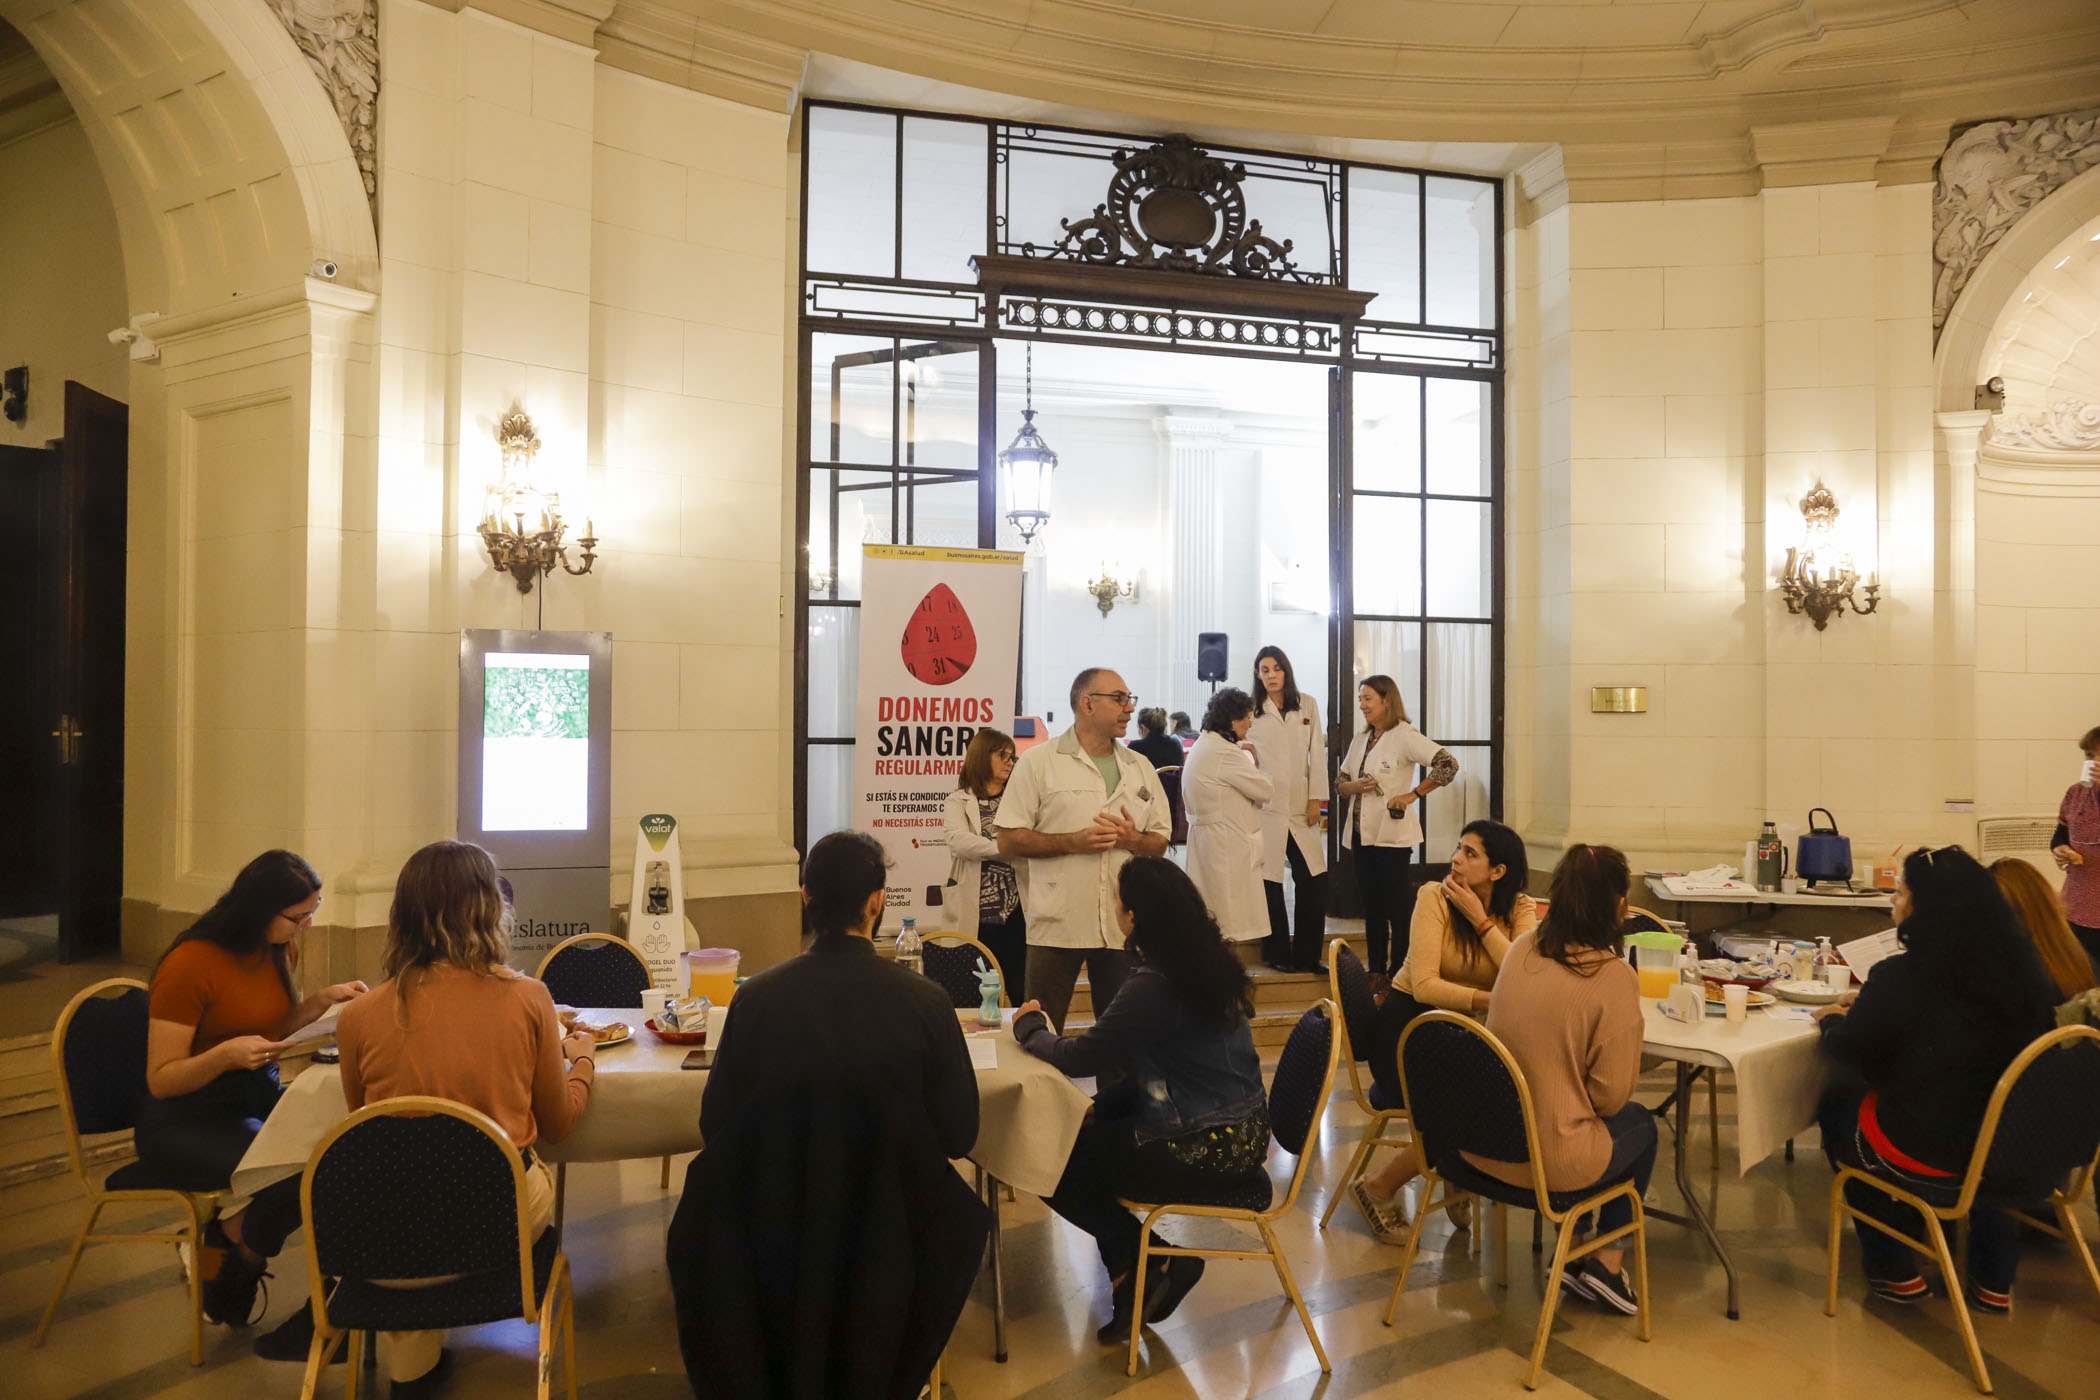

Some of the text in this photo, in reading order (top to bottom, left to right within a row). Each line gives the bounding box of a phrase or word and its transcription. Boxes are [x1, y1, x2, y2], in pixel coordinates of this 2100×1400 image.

[925, 626, 940, 643] 24
[932, 657, 946, 675] 31
[878, 696, 994, 723] DONEMOS
[877, 725, 992, 757] SANGR
[866, 793, 874, 802] SI
[875, 789, 897, 802] ESTÁS
[899, 792, 908, 801] EN
[883, 804, 891, 813] TE
[893, 804, 938, 813] ESPERAMOS
[872, 818, 884, 828] NO
[885, 816, 924, 828] NECESITÁS
[513, 918, 591, 938] islatura
